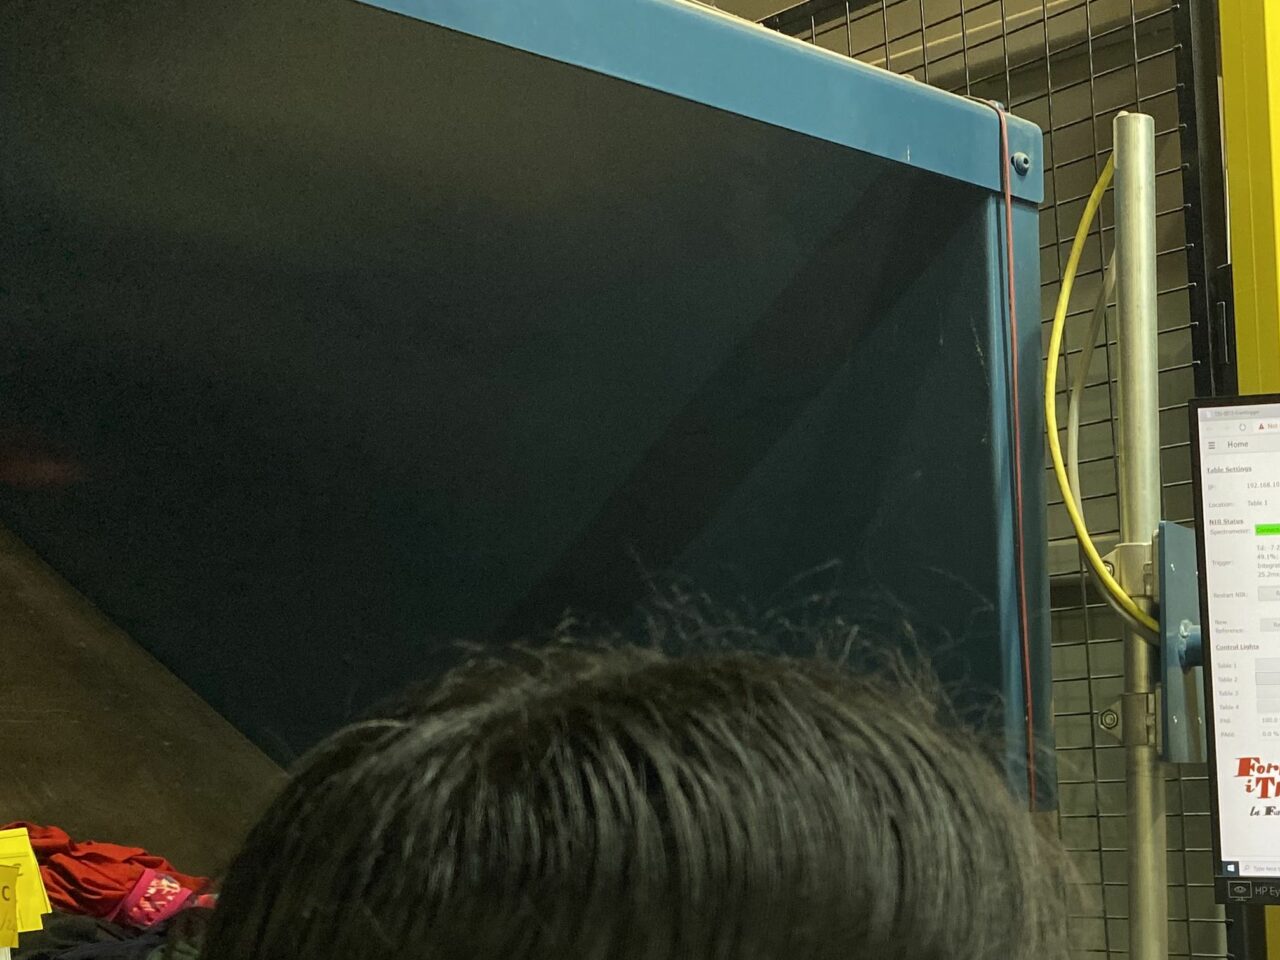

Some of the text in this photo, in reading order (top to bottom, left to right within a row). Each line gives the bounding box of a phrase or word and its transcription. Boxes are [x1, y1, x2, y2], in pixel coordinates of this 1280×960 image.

[1225, 465, 1252, 474] Settings
[1223, 518, 1244, 526] Status
[1255, 887, 1268, 895] HP
